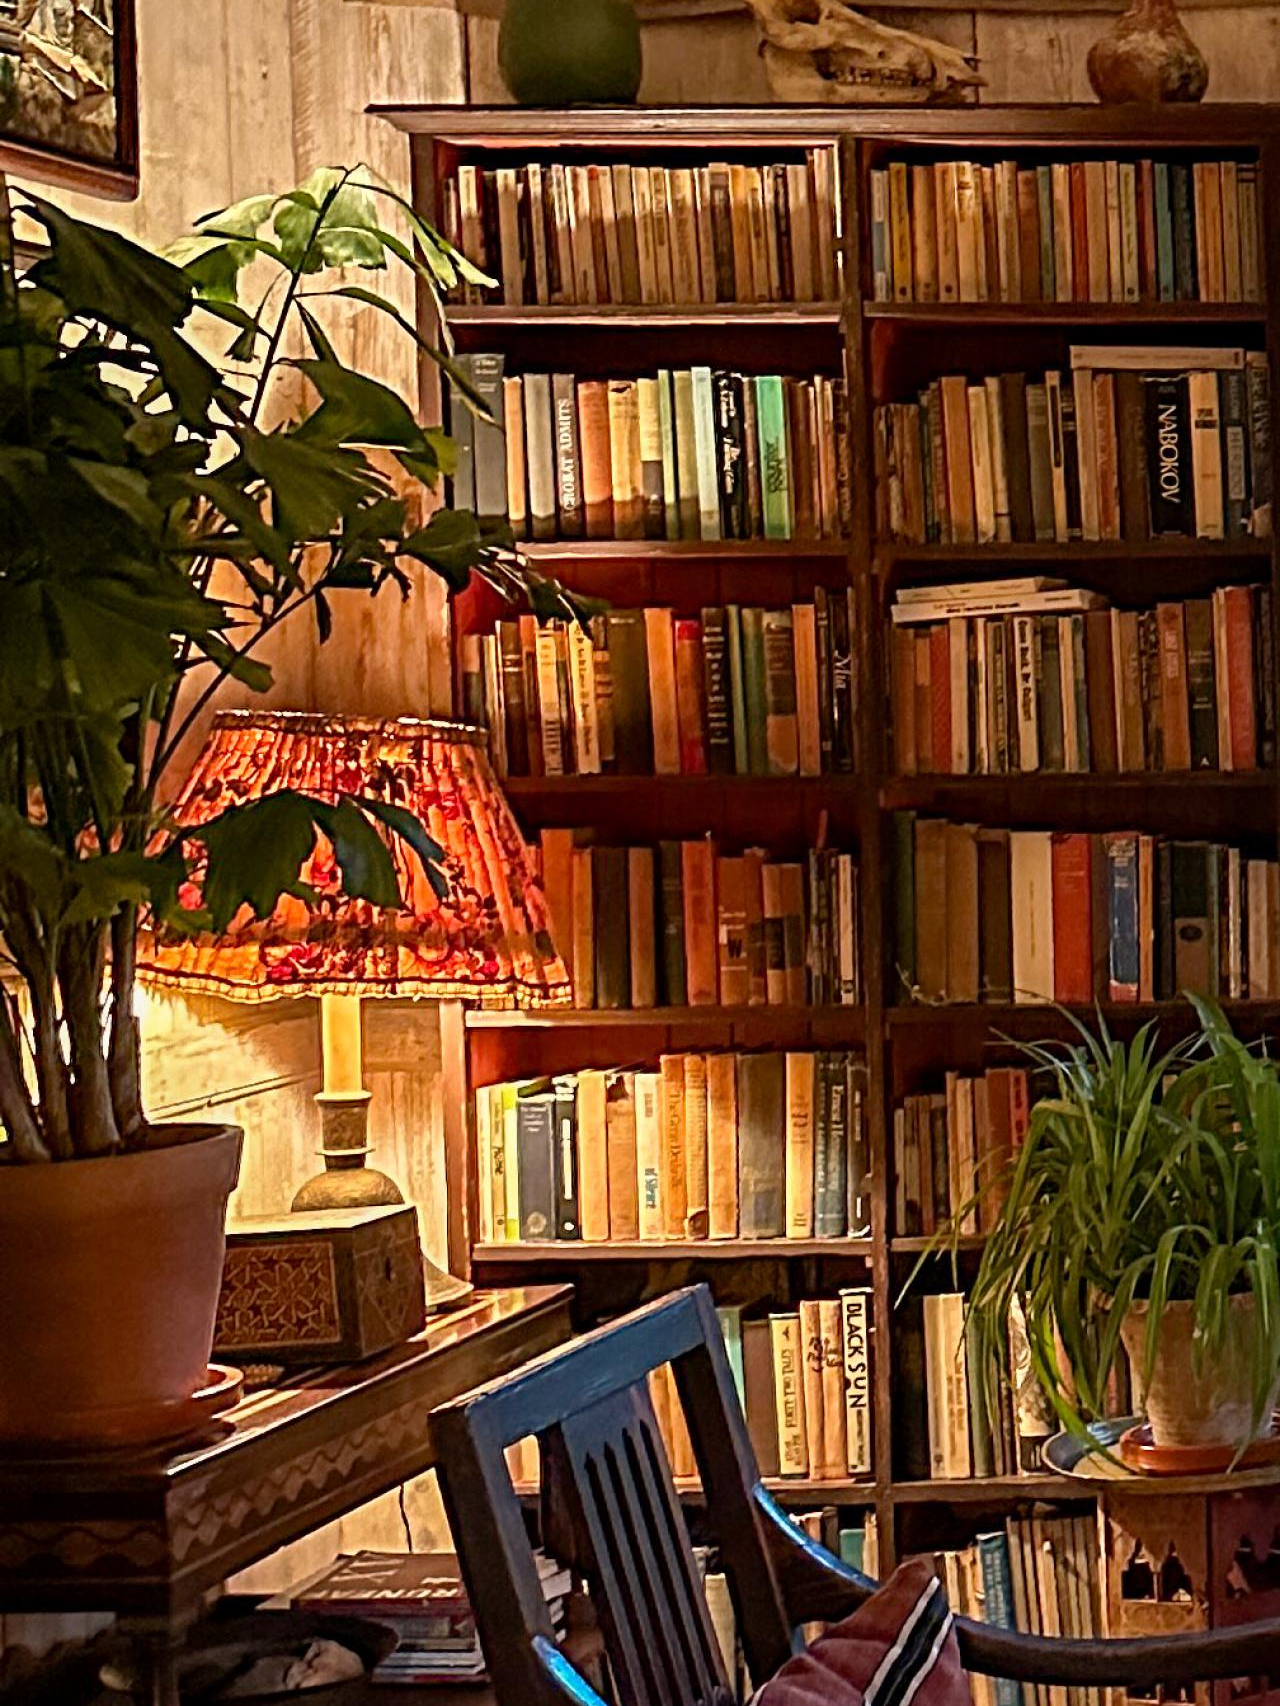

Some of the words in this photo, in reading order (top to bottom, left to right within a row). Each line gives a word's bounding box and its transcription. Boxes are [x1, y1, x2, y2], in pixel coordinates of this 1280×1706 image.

[556, 398, 573, 454] ADMITS
[1157, 403, 1181, 504] NABOKOV
[560, 457, 578, 520] ACROBAT
[846, 1302, 864, 1358] BLACK
[847, 1362, 867, 1409] SUN
